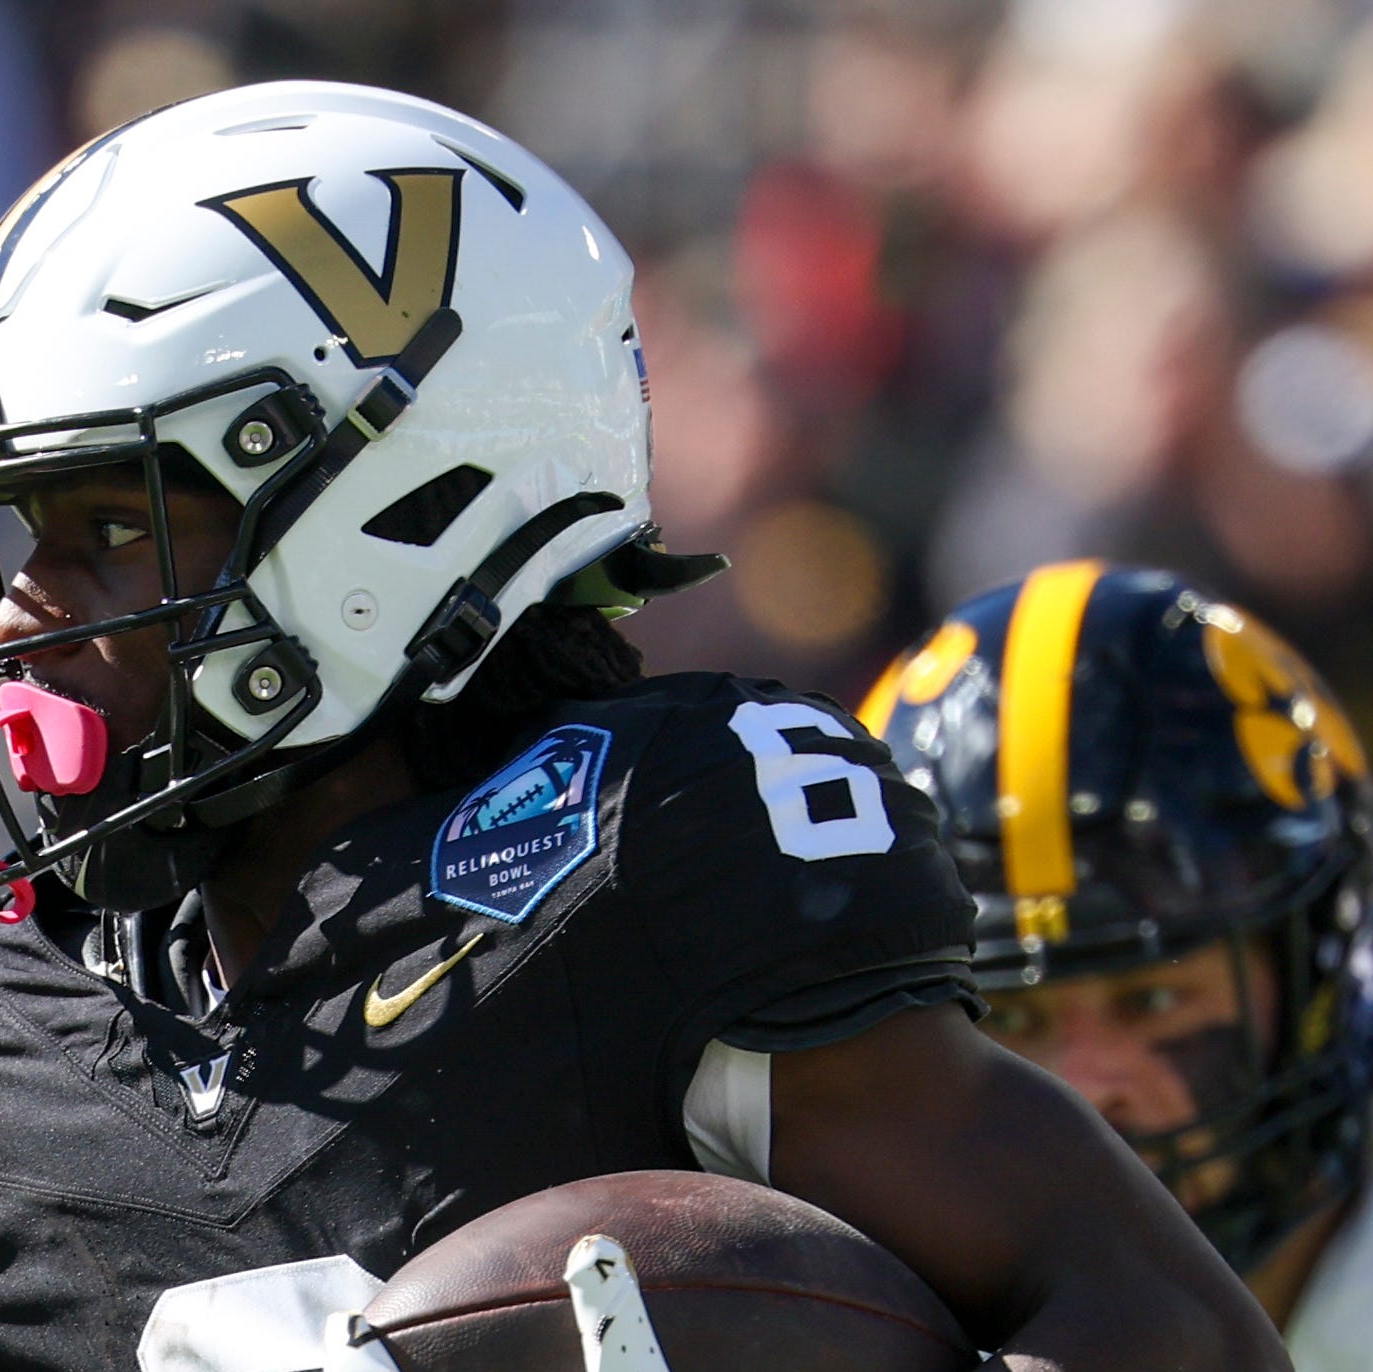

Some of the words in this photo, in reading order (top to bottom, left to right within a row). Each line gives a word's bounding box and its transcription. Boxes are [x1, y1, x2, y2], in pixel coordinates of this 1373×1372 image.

[196, 167, 467, 370] V
[728, 702, 897, 862] 6
[446, 831, 565, 880] RELIAQUEST
[489, 863, 532, 887] BOWL
[179, 1052, 232, 1119] V
